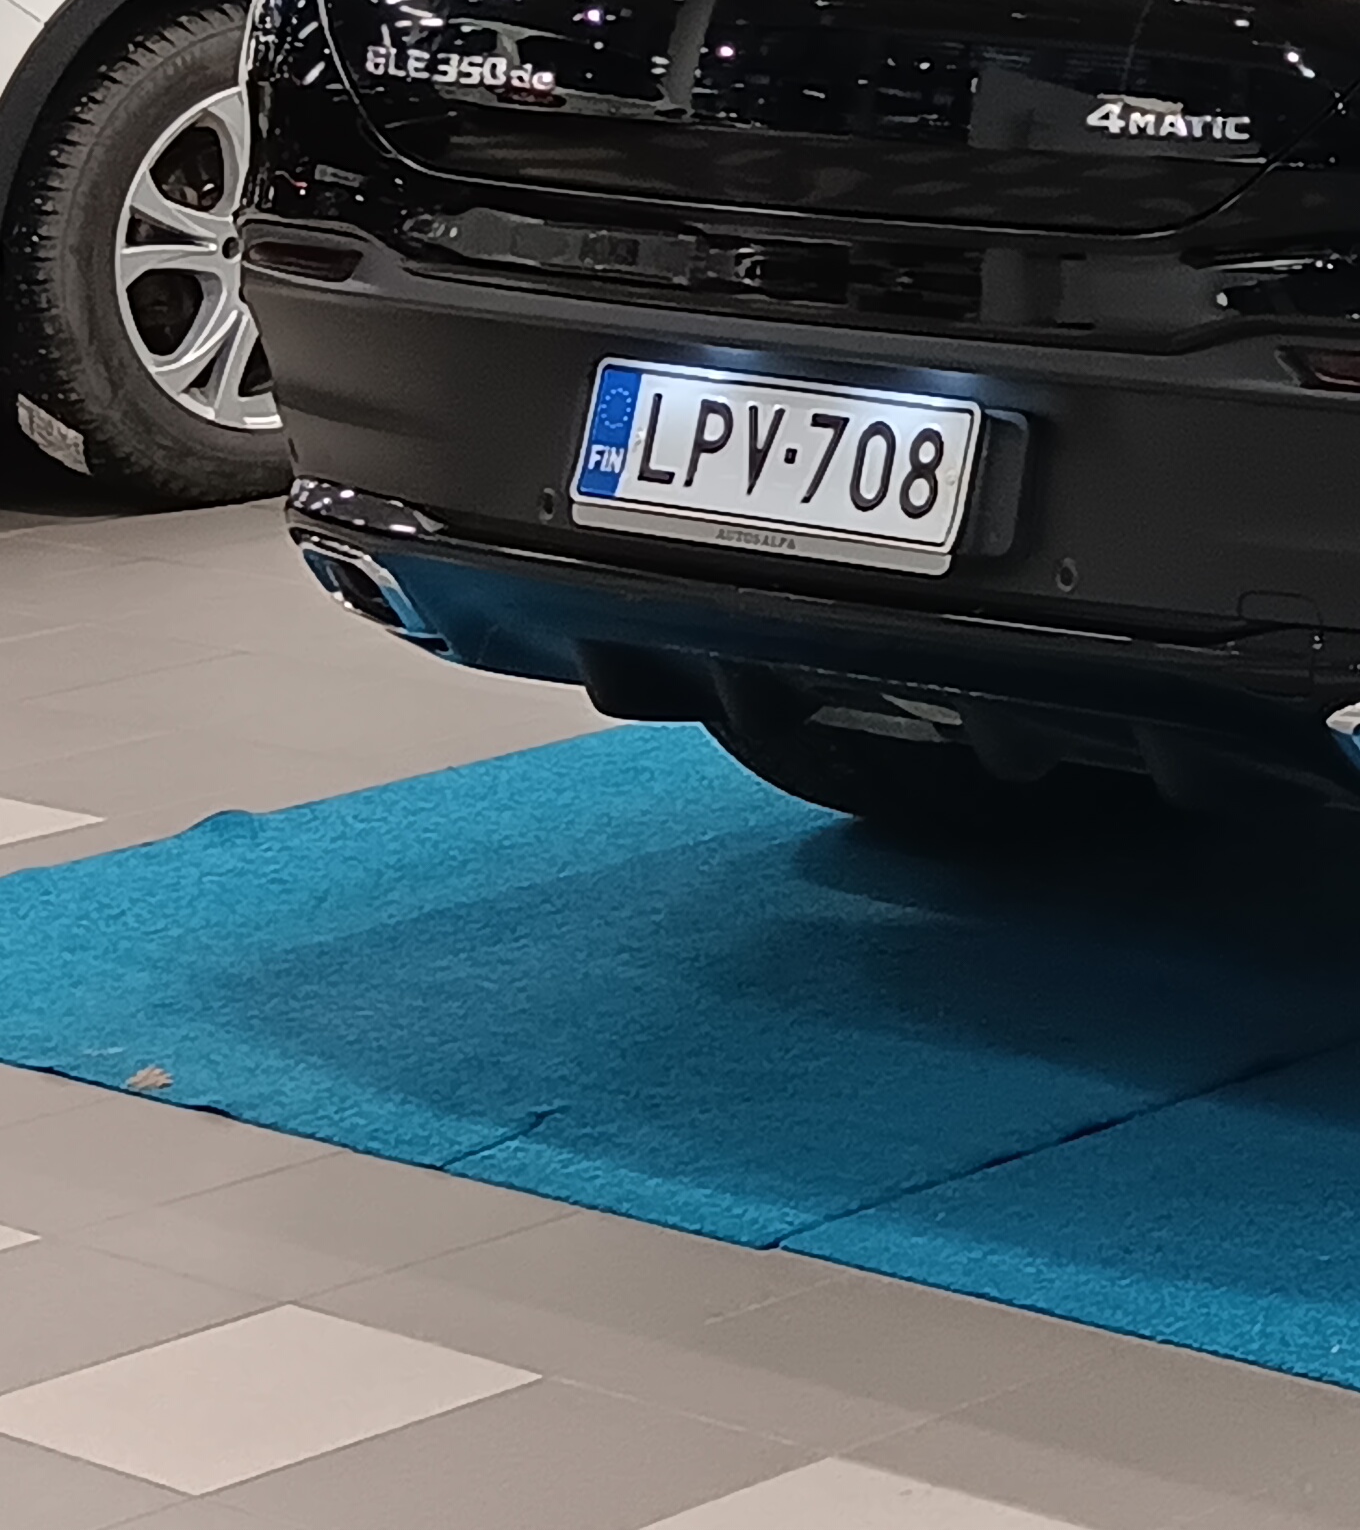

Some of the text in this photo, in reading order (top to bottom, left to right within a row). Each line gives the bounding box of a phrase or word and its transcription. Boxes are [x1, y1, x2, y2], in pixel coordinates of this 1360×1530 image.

[1086, 102, 1251, 140] 4MATIC
[588, 444, 626, 473] FIN
[637, 393, 944, 519] LPV-708
